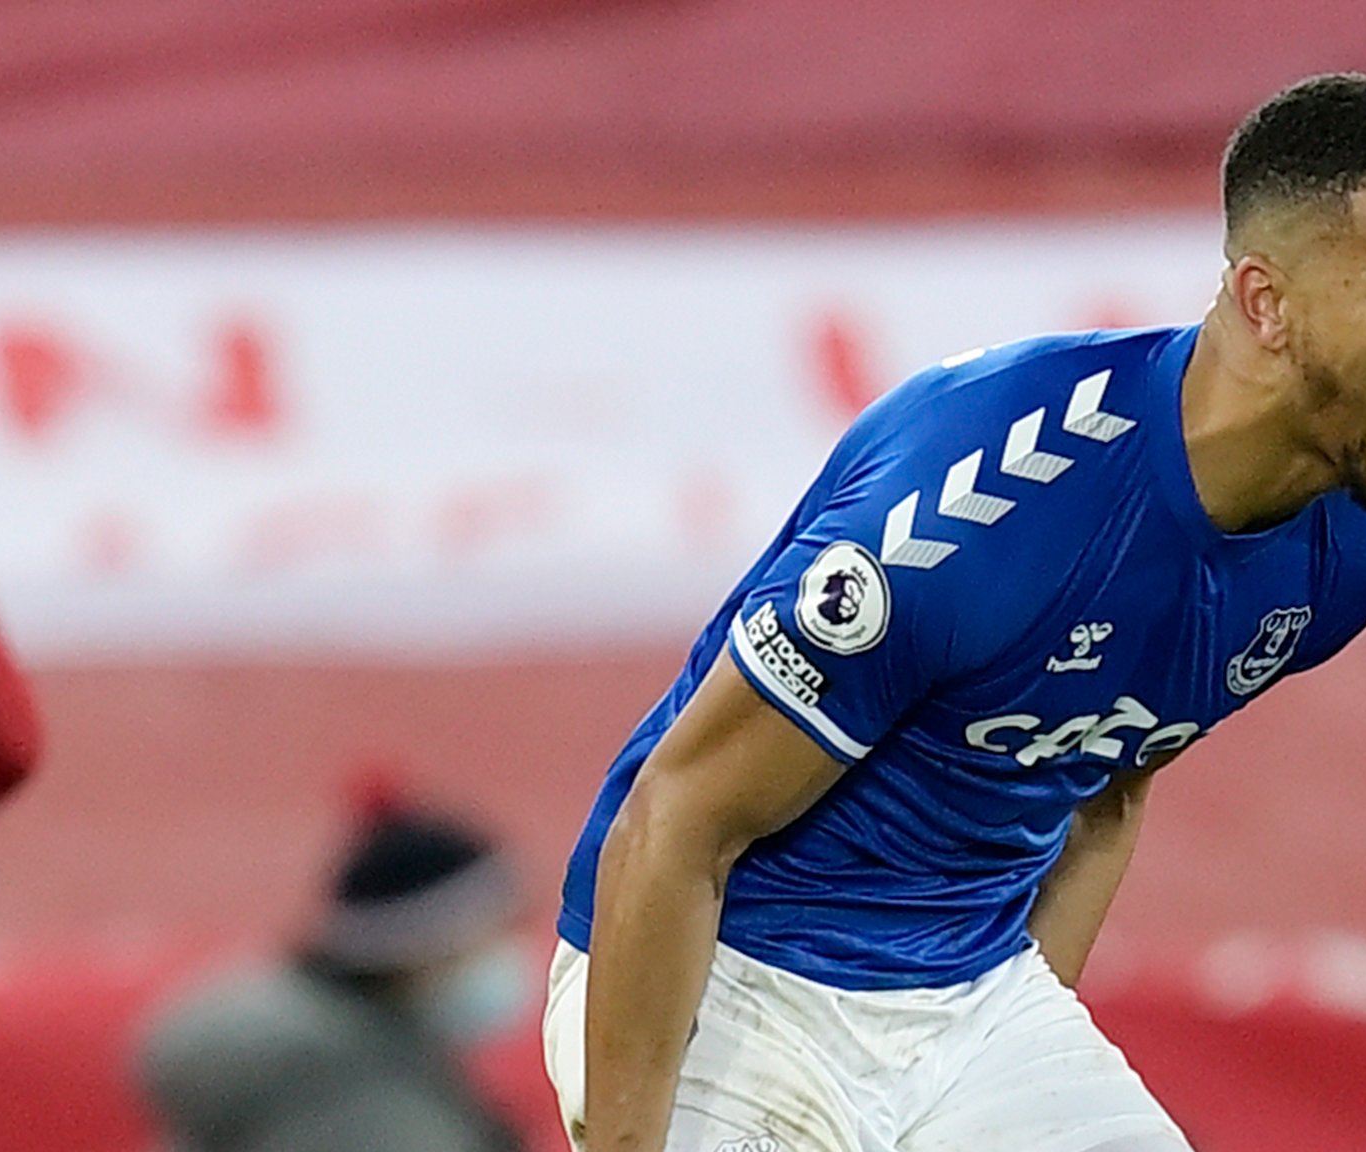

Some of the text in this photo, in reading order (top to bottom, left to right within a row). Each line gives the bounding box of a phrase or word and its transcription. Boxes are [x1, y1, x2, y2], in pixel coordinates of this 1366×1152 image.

[751, 600, 824, 689] No room
[758, 643, 820, 708] racism
